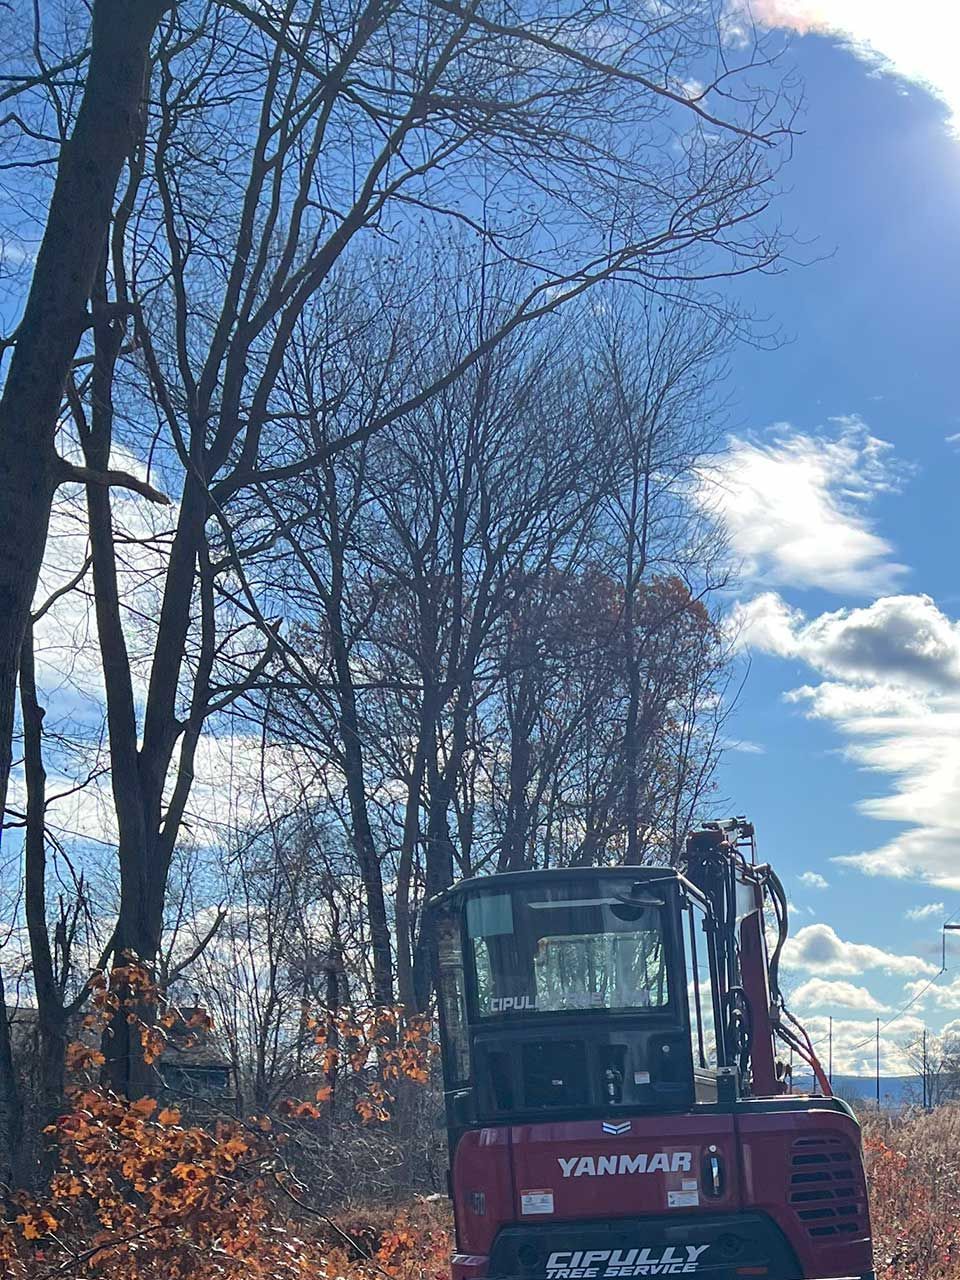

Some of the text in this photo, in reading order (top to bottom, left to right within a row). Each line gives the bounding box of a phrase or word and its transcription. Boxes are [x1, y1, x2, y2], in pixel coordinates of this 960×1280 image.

[557, 1152, 692, 1178] YANMAR
[545, 1244, 711, 1269] CIPULLY
[546, 1262, 699, 1280] TREE SERVICE
